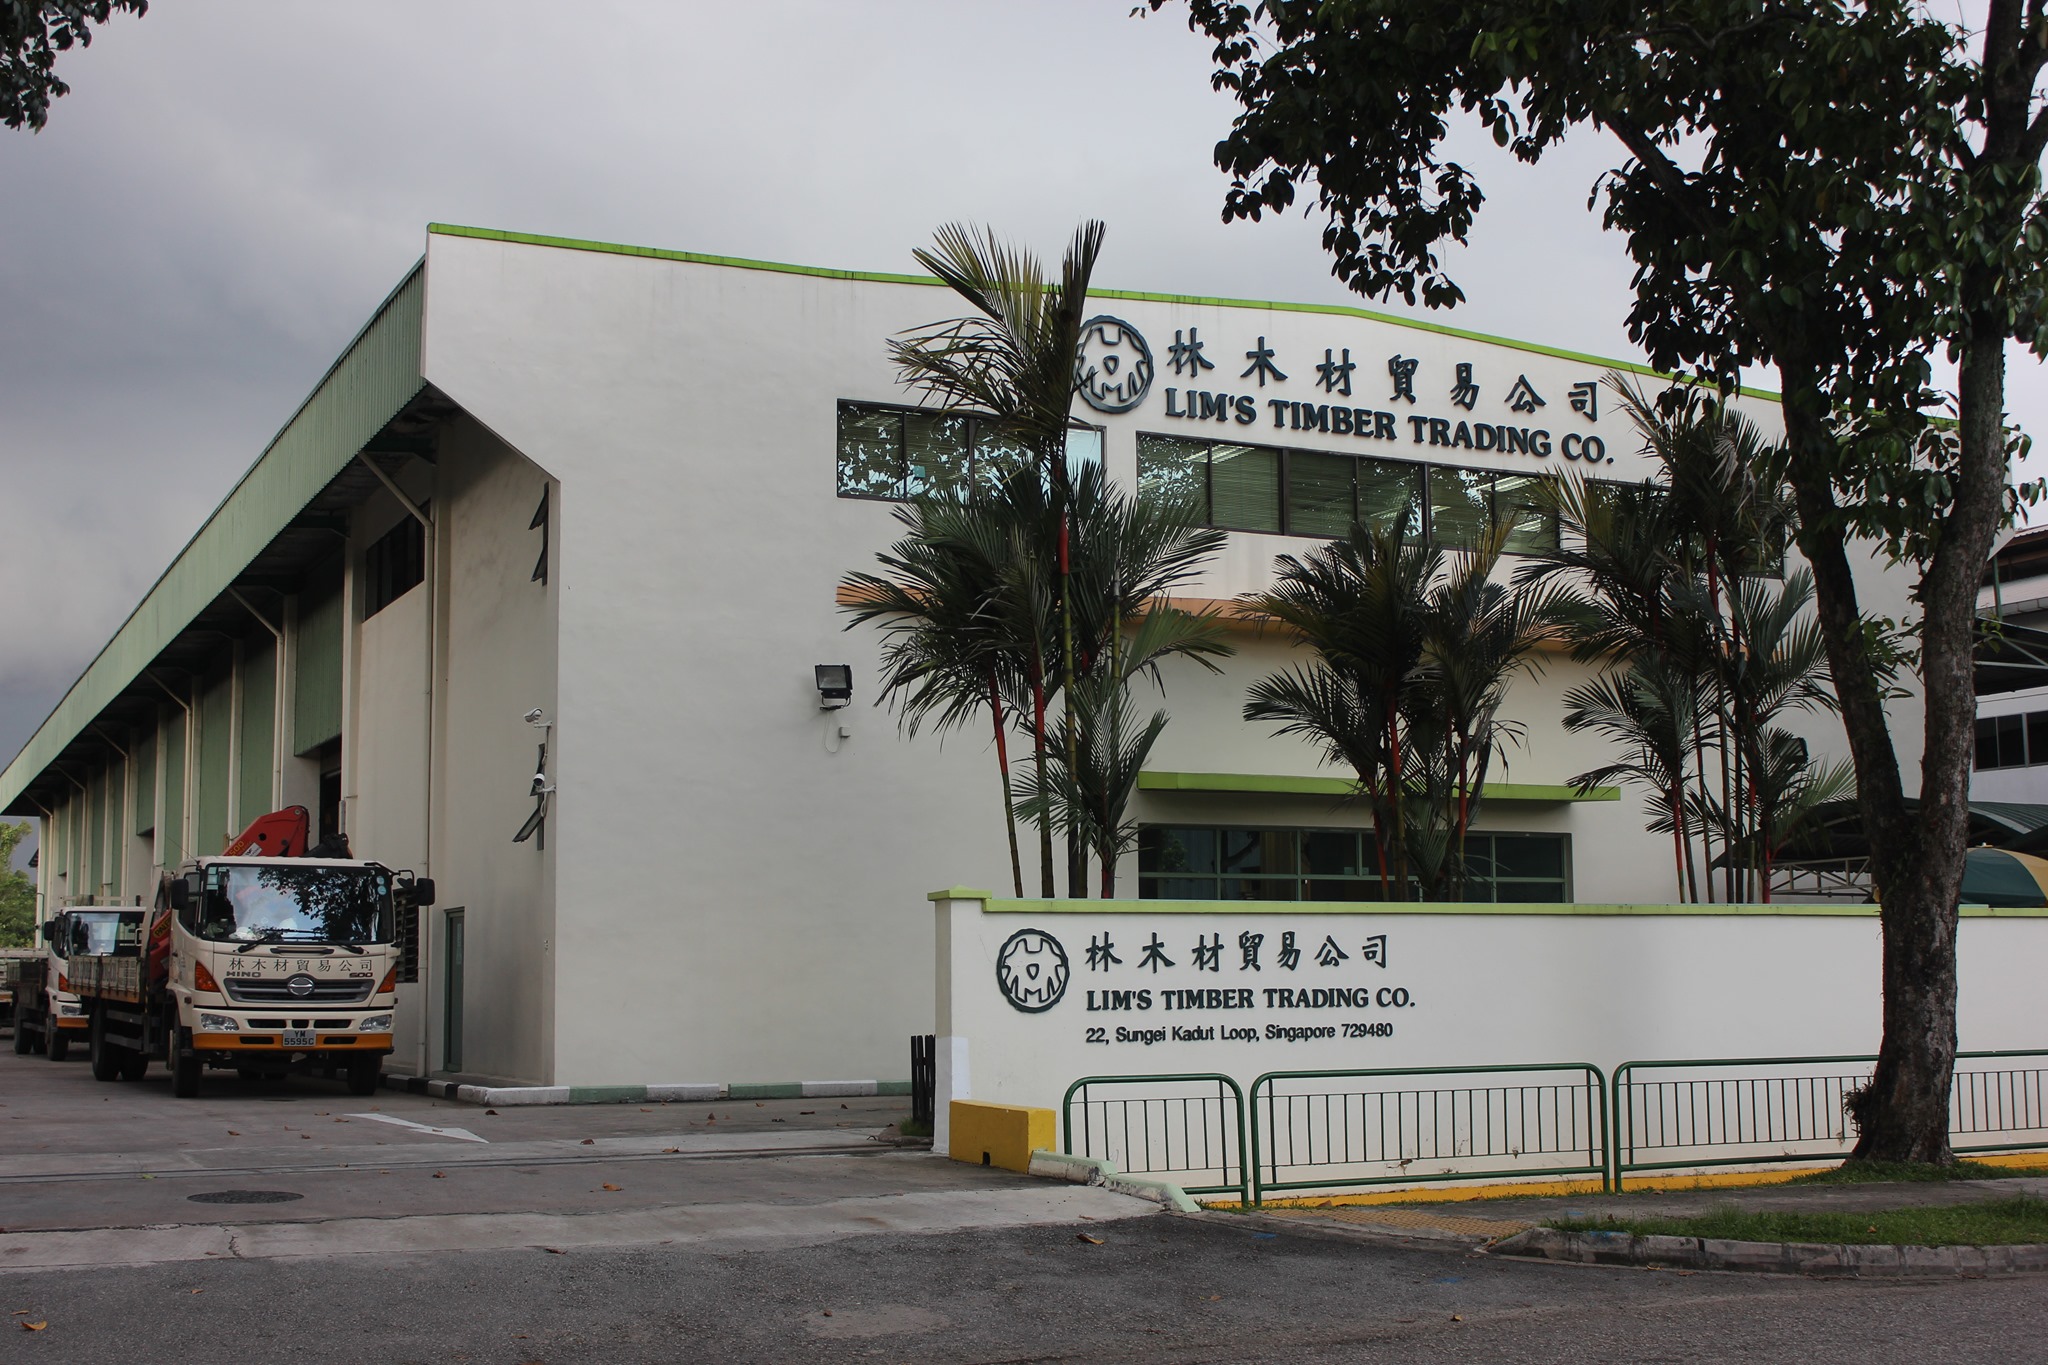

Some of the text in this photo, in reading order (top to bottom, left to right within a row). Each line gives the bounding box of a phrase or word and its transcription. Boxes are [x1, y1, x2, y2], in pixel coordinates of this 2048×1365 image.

[1167, 327, 1598, 423] 林木材貿易公司
[1165, 387, 1614, 464] LIM'S TIMBER TRADING CO.
[1085, 931, 1387, 973] 林木材貿易公司
[229, 957, 373, 972] 林木材貿易公司
[1086, 987, 1416, 1011] LIM'S TIMBER TRADING CO.
[284, 1037, 314, 1046] 5595C
[1086, 1022, 1393, 1045] 22, Sungei Kadut Loop, Singapore 729480
